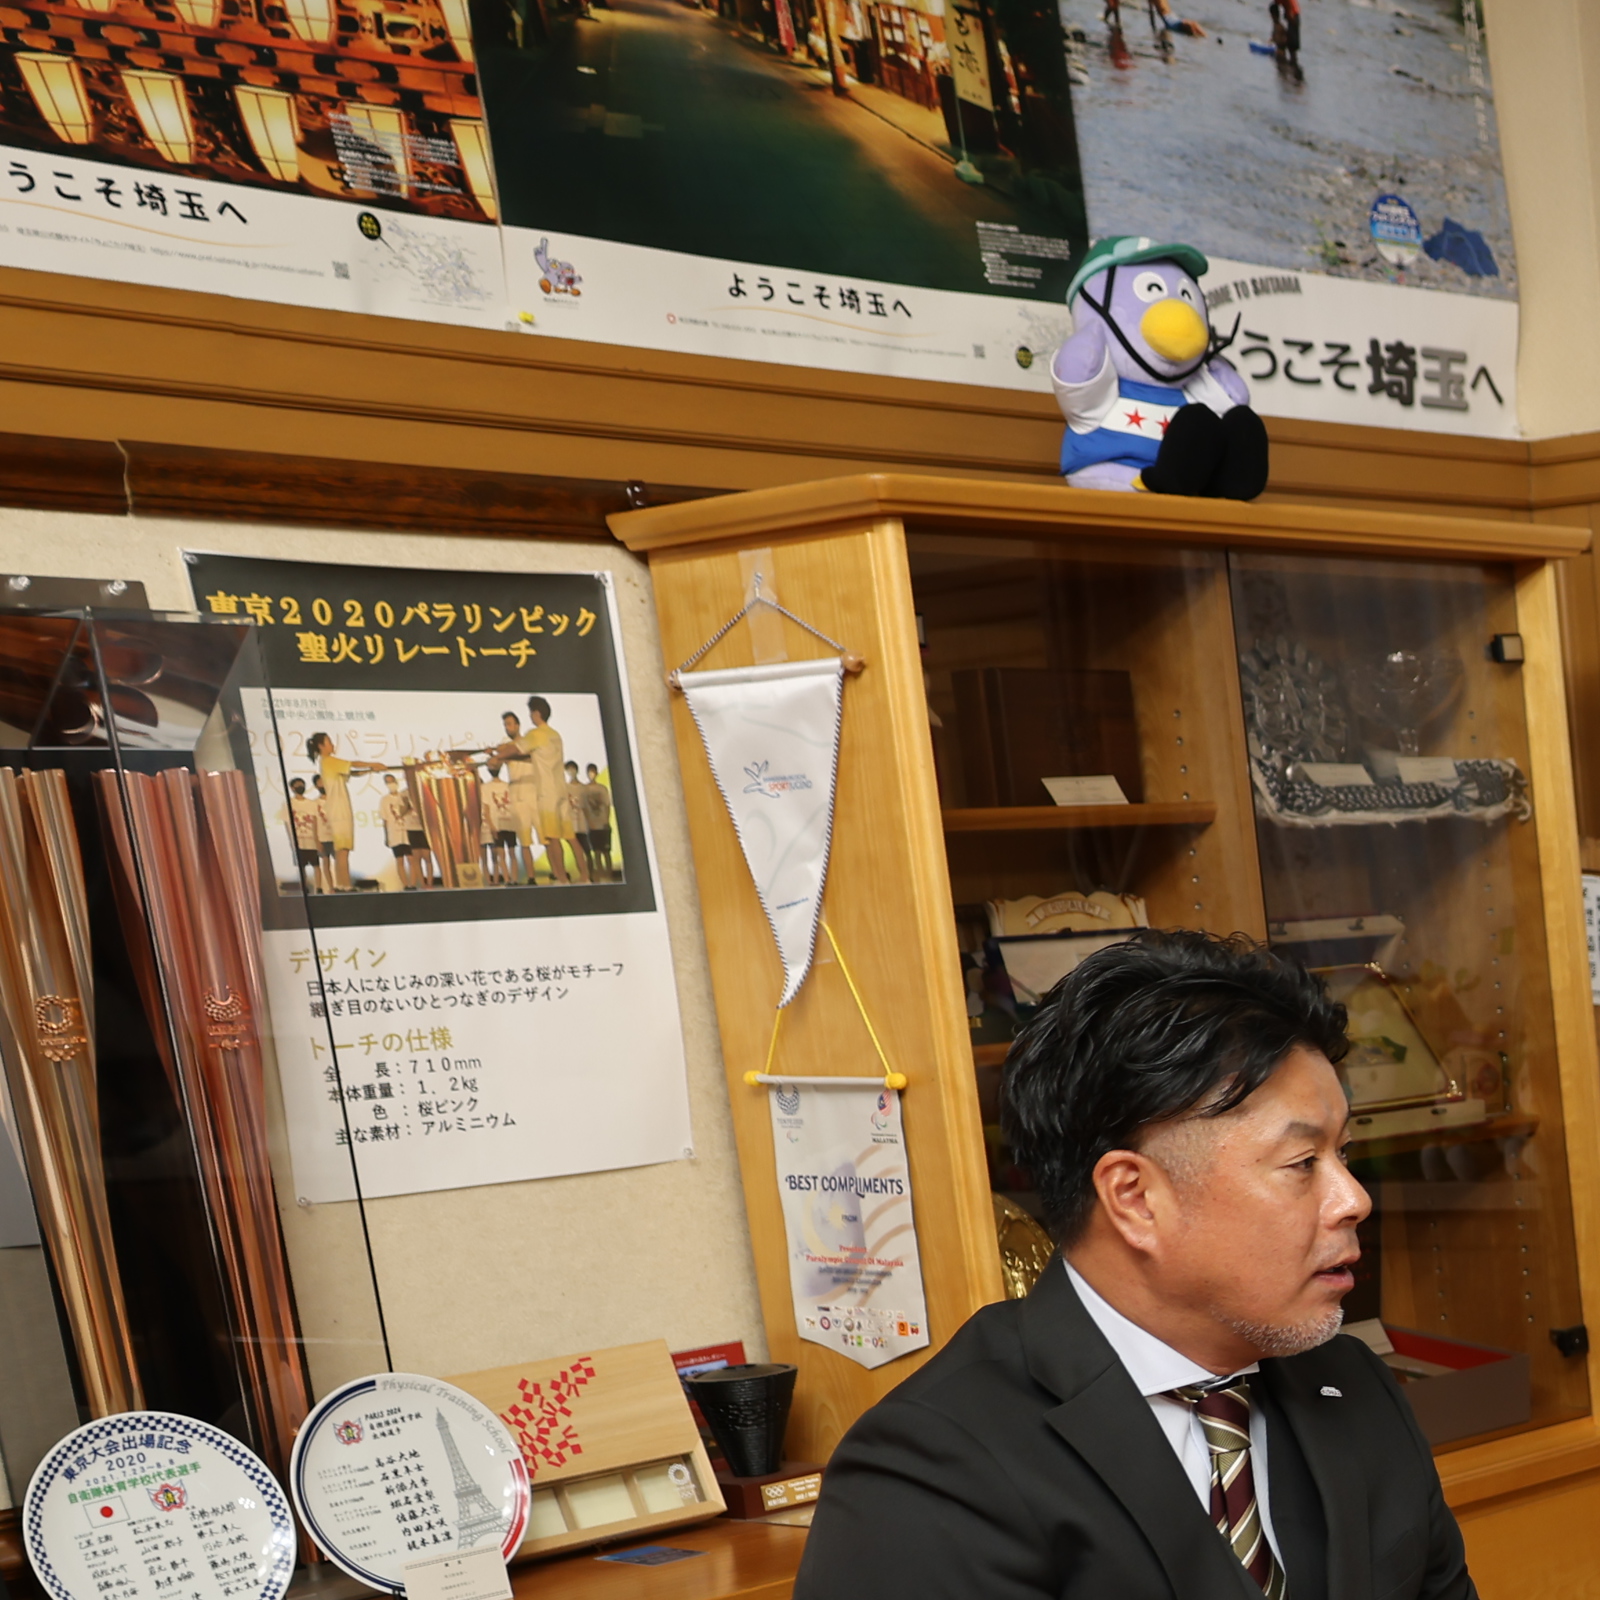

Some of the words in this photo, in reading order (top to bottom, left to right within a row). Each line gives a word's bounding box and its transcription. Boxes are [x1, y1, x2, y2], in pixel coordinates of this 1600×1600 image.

[9, 161, 248, 225] うこそ埼玉へ
[729, 273, 912, 318] ようこそ埼玉へ
[1234, 280, 1251, 299] TO
[1251, 276, 1302, 297] SAITAMA
[206, 589, 598, 638] 東京2020パラリンピック
[296, 631, 537, 668] 聖火リレートーチ
[289, 947, 387, 976] デザイン
[310, 1026, 455, 1061] トーチの仕様
[785, 1175, 818, 1190] BEST
[821, 1176, 904, 1198] COMPLIMENTS
[61, 1433, 193, 1484] 東京大会出場記念
[106, 1452, 147, 1472] 2020
[67, 1461, 202, 1505] 自衛隊体育学校代表選手
